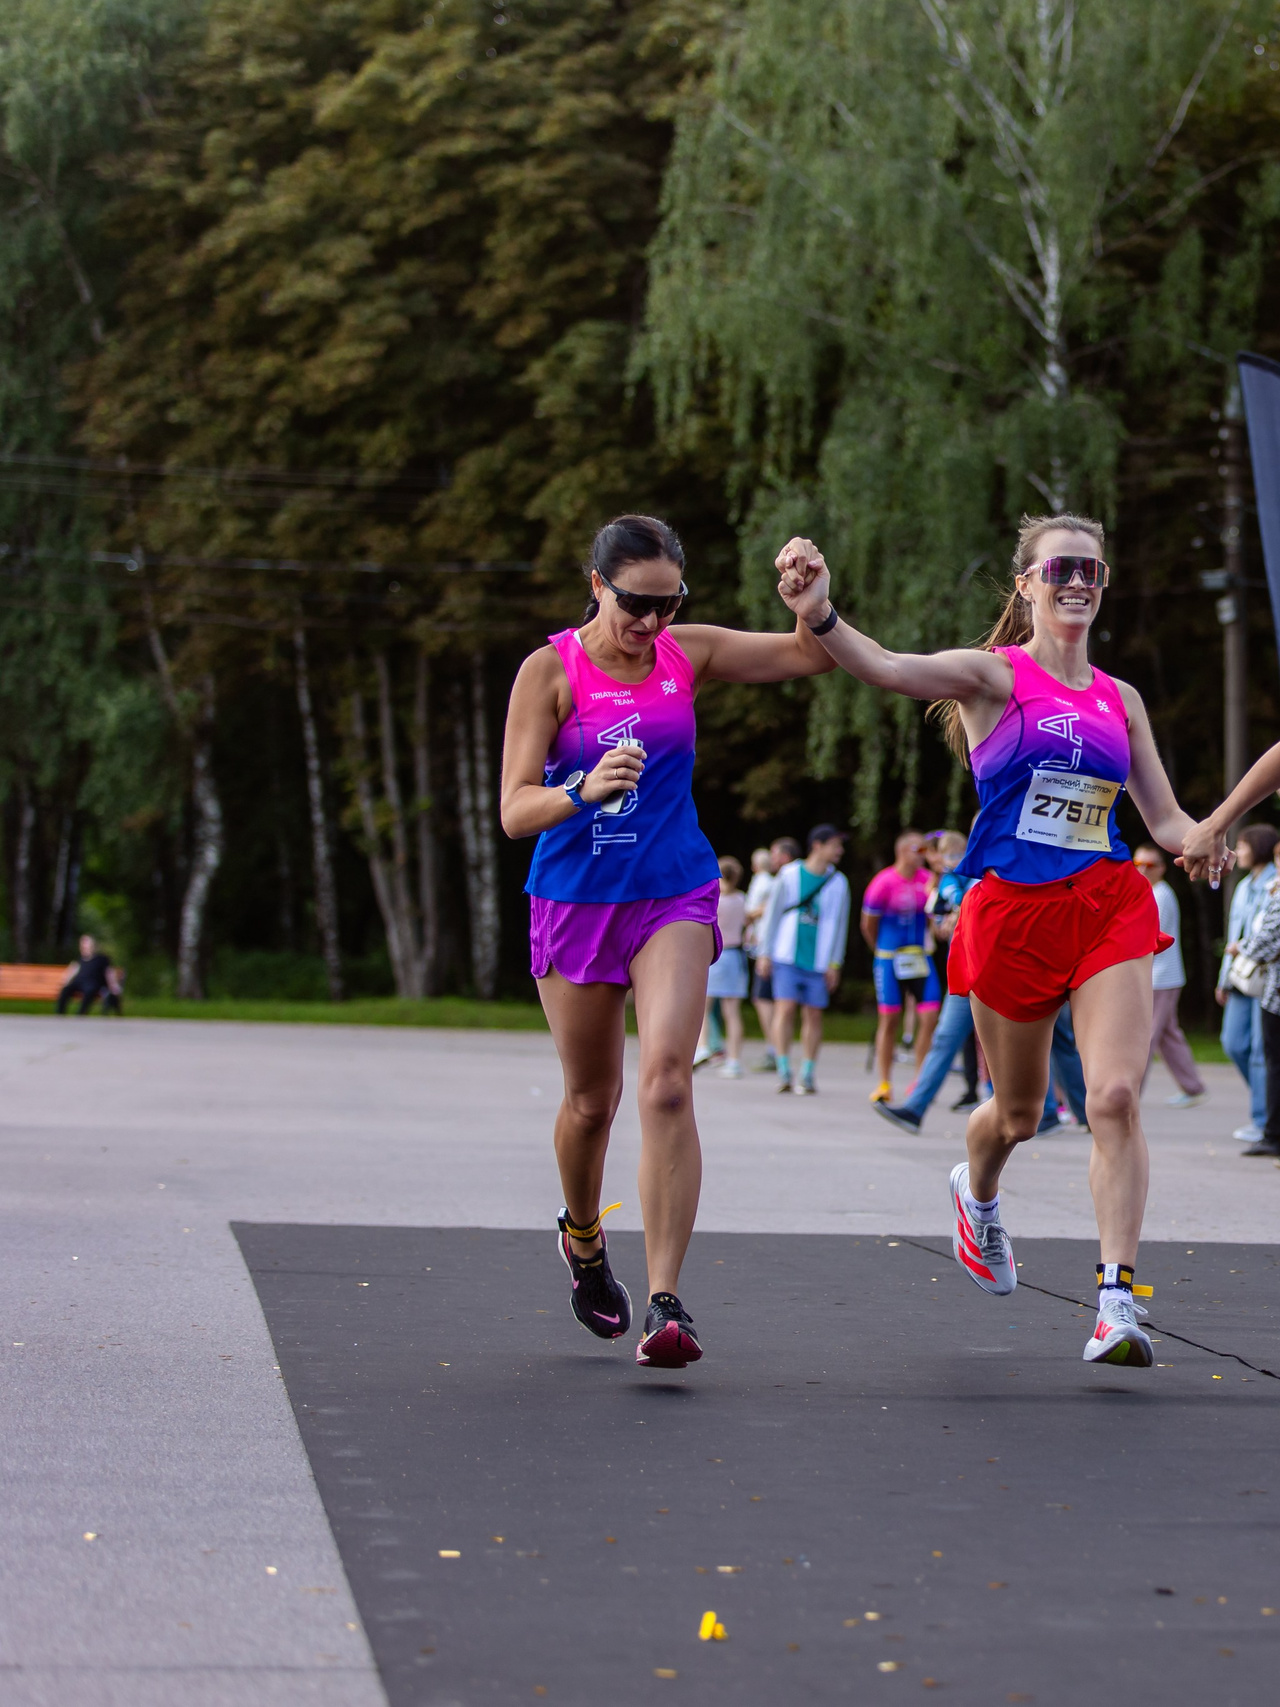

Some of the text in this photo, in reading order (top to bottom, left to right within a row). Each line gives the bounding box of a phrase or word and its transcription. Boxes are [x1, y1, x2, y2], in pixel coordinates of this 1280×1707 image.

[590, 689, 632, 700] TRIATHLON
[613, 698, 635, 706] TEAM
[1042, 777, 1081, 788] ТУЛЬСКИЙ
[1031, 793, 1084, 823] 275
